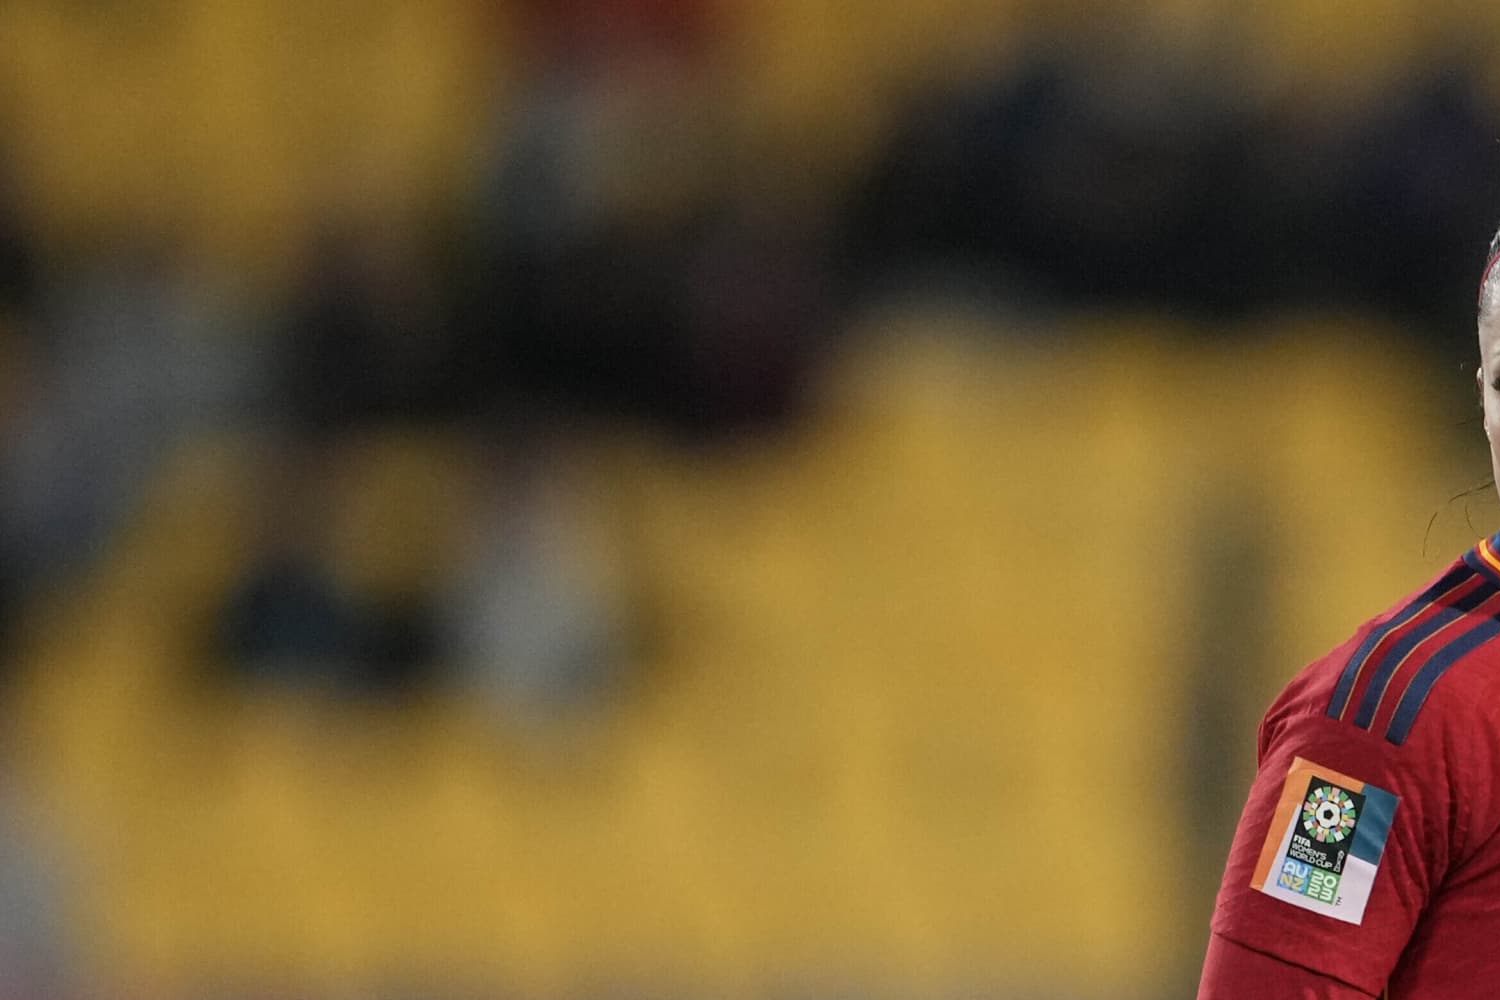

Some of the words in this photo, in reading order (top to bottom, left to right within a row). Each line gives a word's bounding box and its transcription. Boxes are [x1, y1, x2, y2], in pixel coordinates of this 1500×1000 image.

[1294, 834, 1311, 847] FIFA
[1289, 847, 1315, 864] WORLD
[1316, 859, 1333, 868] CUP
[1291, 842, 1327, 860] WOMEN'S
[1283, 860, 1308, 879] AU
[1282, 873, 1305, 891] NZ
